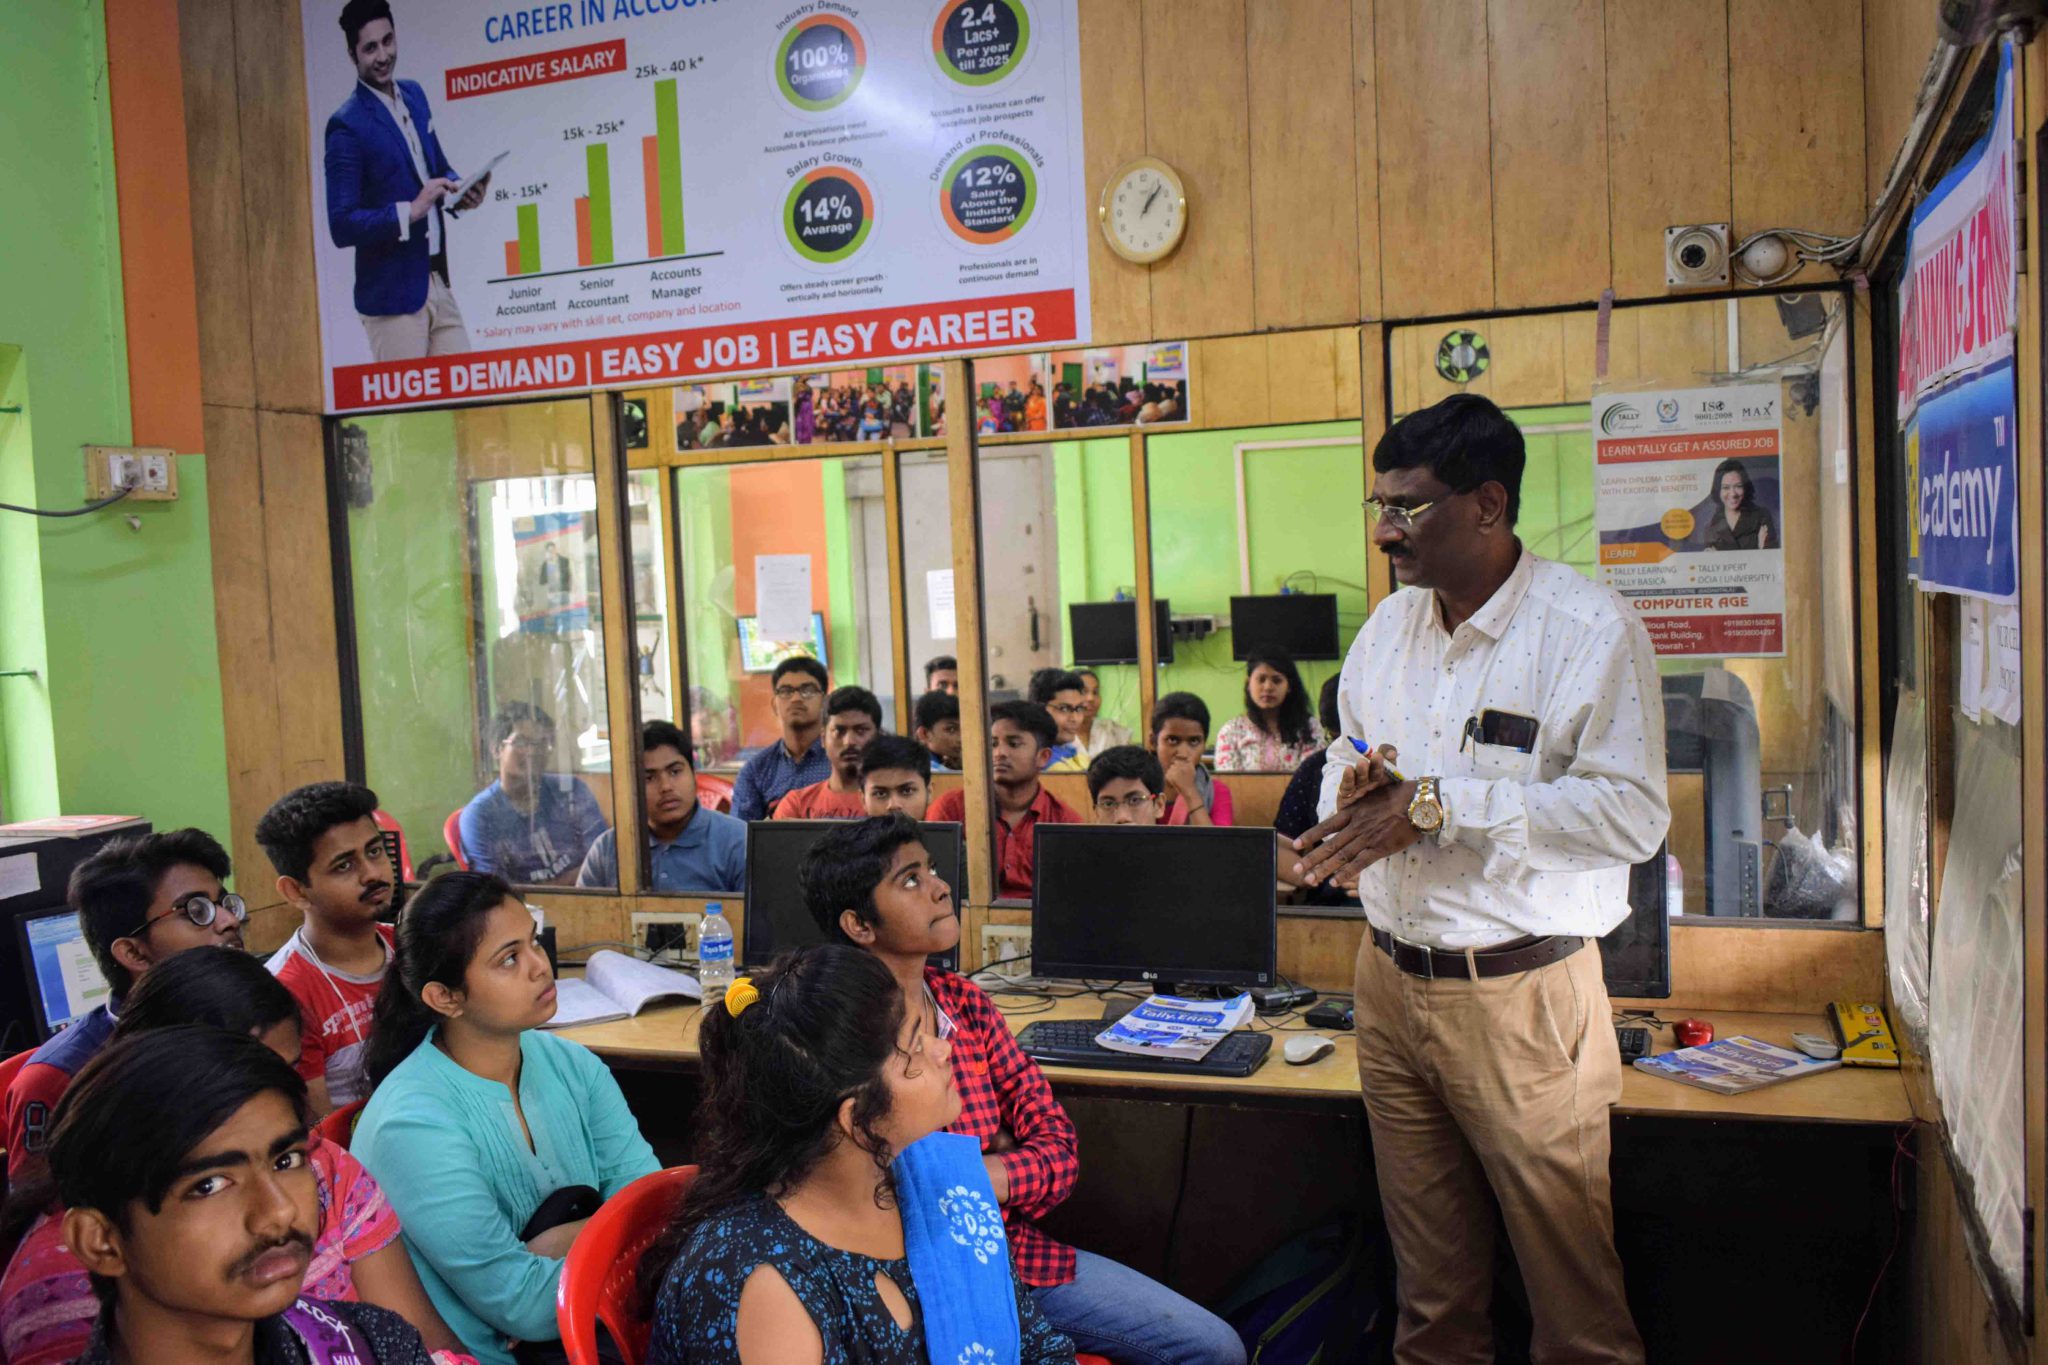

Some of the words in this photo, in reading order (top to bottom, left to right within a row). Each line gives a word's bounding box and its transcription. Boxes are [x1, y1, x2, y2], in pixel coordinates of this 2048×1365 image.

[485, 4, 573, 43] CAREER
[581, 0, 605, 26] IN
[776, 2, 814, 31] Industry
[818, 0, 859, 18] Demand
[961, 3, 996, 28] 2.4
[965, 27, 999, 44] Lacs+
[789, 44, 848, 70] 100%
[957, 47, 978, 58] Per
[982, 42, 1011, 56] year
[635, 64, 658, 78] 25k
[670, 61, 686, 72] 40
[959, 59, 975, 71] till
[979, 54, 1010, 68] 2025
[451, 62, 546, 94] INDICATIVE
[550, 49, 616, 77] SALARY
[976, 101, 1007, 111] Finance
[1025, 95, 1045, 104] offer
[978, 116, 992, 125] job
[994, 110, 1033, 122] prospects
[563, 127, 585, 140] 15k
[930, 141, 963, 181] Demand
[965, 133, 976, 144] of
[980, 130, 1044, 168] Professionals
[786, 155, 819, 178] Salary
[823, 152, 863, 168] Growth
[961, 164, 1016, 187] 12%
[495, 189, 509, 201] 8k
[960, 200, 996, 209] Above
[999, 196, 1017, 204] the
[970, 189, 1006, 199] Salary
[800, 194, 852, 222] 14%
[966, 206, 1012, 217] Industry
[964, 214, 1015, 226] Standard
[959, 260, 1012, 272] Professionals
[1014, 258, 1027, 266] are
[1029, 256, 1037, 264] in
[650, 266, 702, 283] Accounts
[804, 281, 828, 290] steady
[830, 278, 854, 286] career
[856, 273, 883, 285] growth
[958, 275, 1003, 284] continuous
[1006, 269, 1039, 280] demand
[580, 277, 615, 290] Senior
[508, 286, 542, 299] Junior
[651, 284, 702, 301] Manager
[822, 290, 837, 298] and
[496, 299, 557, 317] Accountant
[567, 293, 629, 311] Accountant
[484, 326, 512, 338] Salary
[515, 325, 535, 334] may
[538, 322, 558, 333] vary
[560, 318, 583, 329] with
[586, 315, 604, 326] skill
[627, 309, 672, 323] company
[676, 305, 696, 316] and
[699, 301, 741, 314] location
[362, 368, 441, 401] HUGE
[450, 355, 576, 398] DEMAND
[602, 342, 685, 378] EASY
[694, 332, 759, 367] JOB
[789, 322, 879, 360] EASY
[890, 306, 1036, 349] CAREER
[1602, 445, 1636, 457] LEARN
[1637, 443, 1667, 455] TALLY
[1669, 441, 1689, 452] GET
[1692, 441, 1700, 451] A
[1702, 438, 1750, 450] ASSURED
[1753, 437, 1774, 447] JOB
[1918, 450, 2002, 565] cademy
[1605, 550, 1636, 559] LEARN
[1614, 567, 1635, 575] TALLY
[1698, 564, 1721, 572] TALLY
[1633, 597, 1713, 610] COMPUTER
[1719, 596, 1750, 608] AGE
[1667, 620, 1691, 629] Road,
